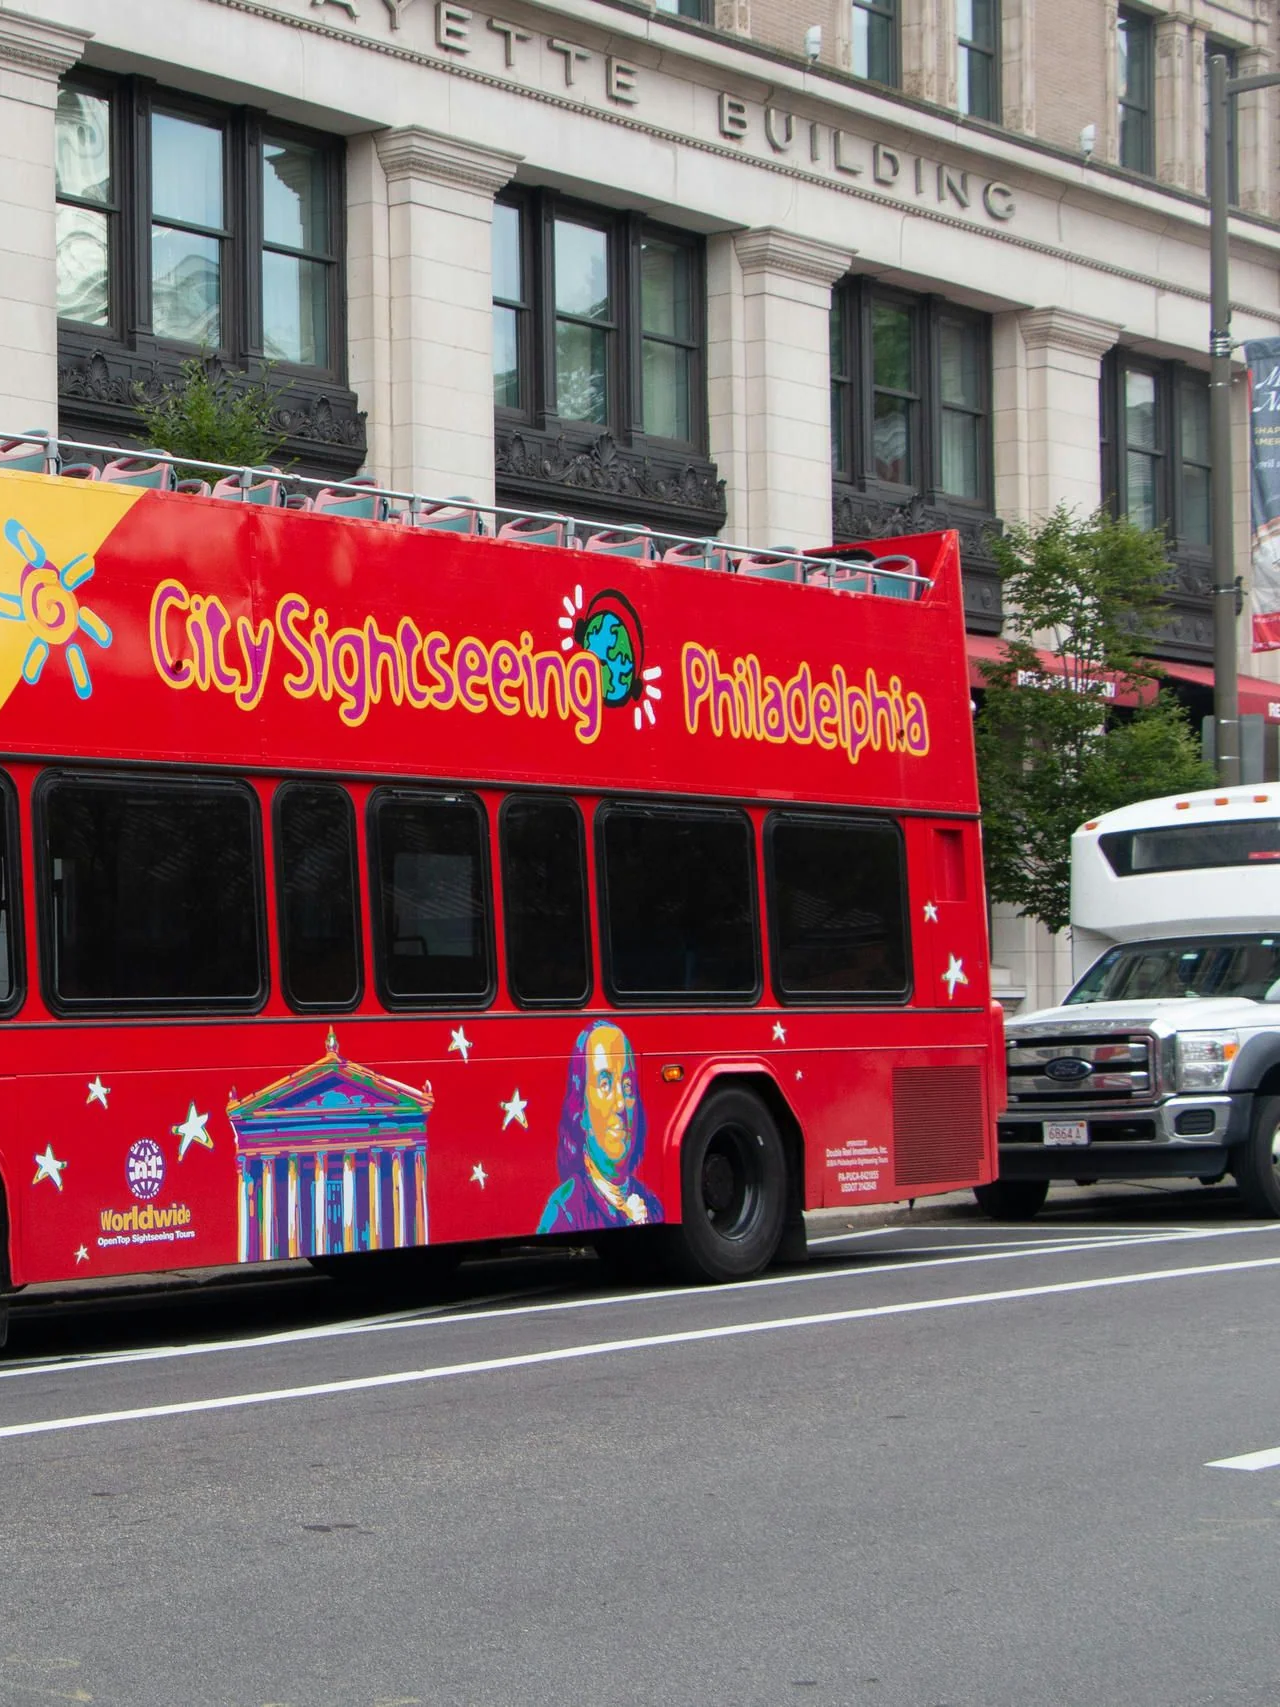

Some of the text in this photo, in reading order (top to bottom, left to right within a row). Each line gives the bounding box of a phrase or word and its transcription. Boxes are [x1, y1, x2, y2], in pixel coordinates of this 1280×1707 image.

[718, 90, 1017, 221] BUILDING
[680, 641, 931, 764] Philadelphia
[97, 1230, 196, 1247] OpenTop Sightseeing Tours
[100, 1202, 191, 1232] Worldwide
